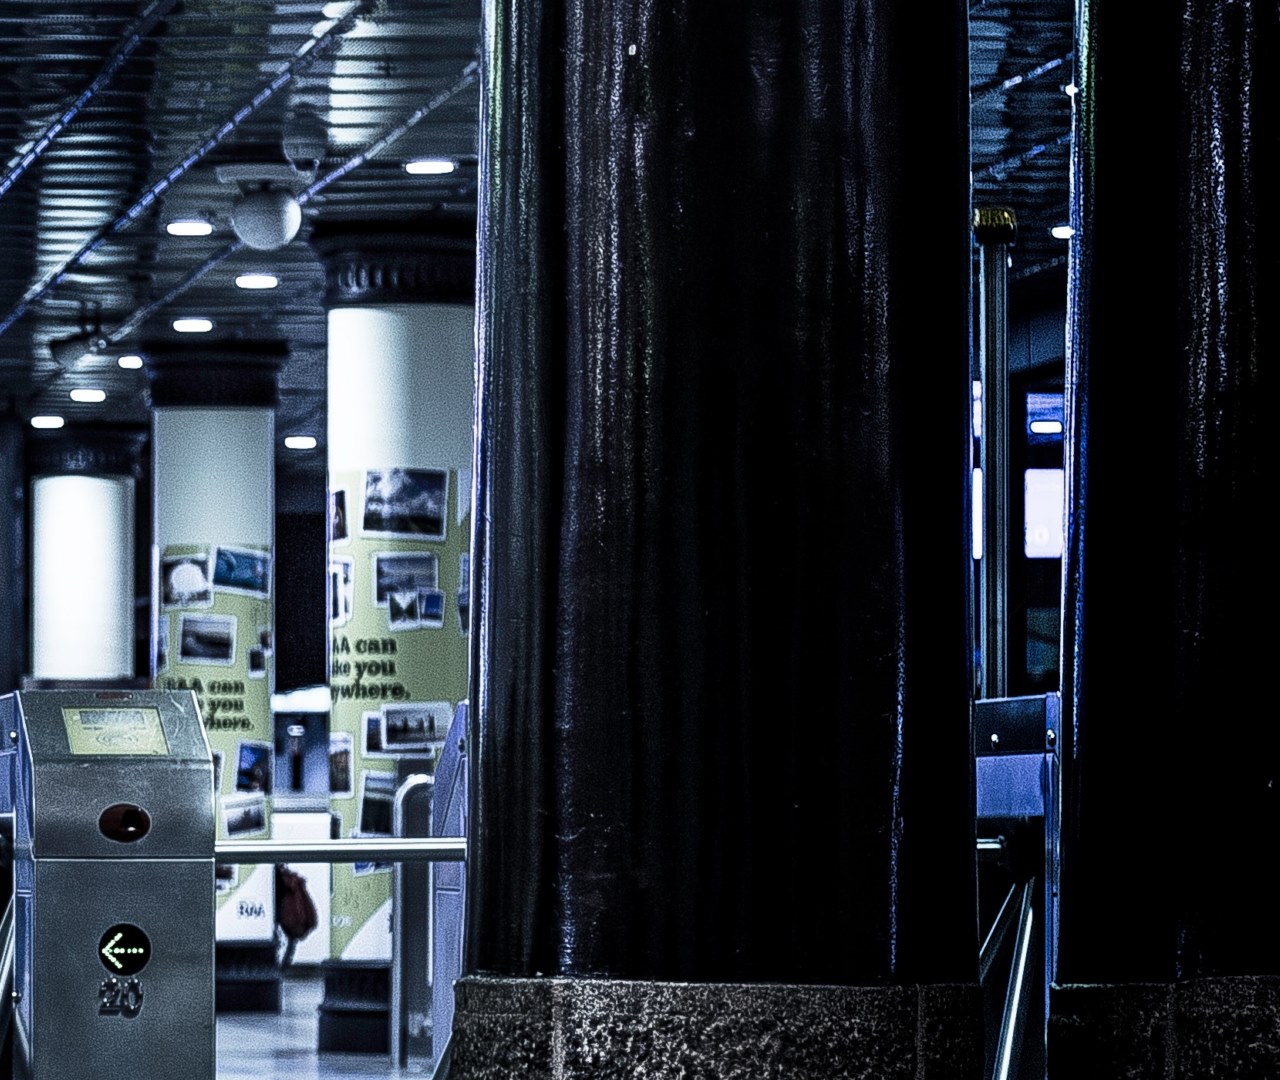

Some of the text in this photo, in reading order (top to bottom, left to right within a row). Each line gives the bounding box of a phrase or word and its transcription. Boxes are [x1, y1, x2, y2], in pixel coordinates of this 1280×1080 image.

[355, 638, 398, 655] can
[355, 660, 397, 681] you
[207, 680, 245, 695] can
[331, 681, 412, 705] ywhere.
[208, 698, 244, 716] you
[99, 978, 144, 1019] 20
